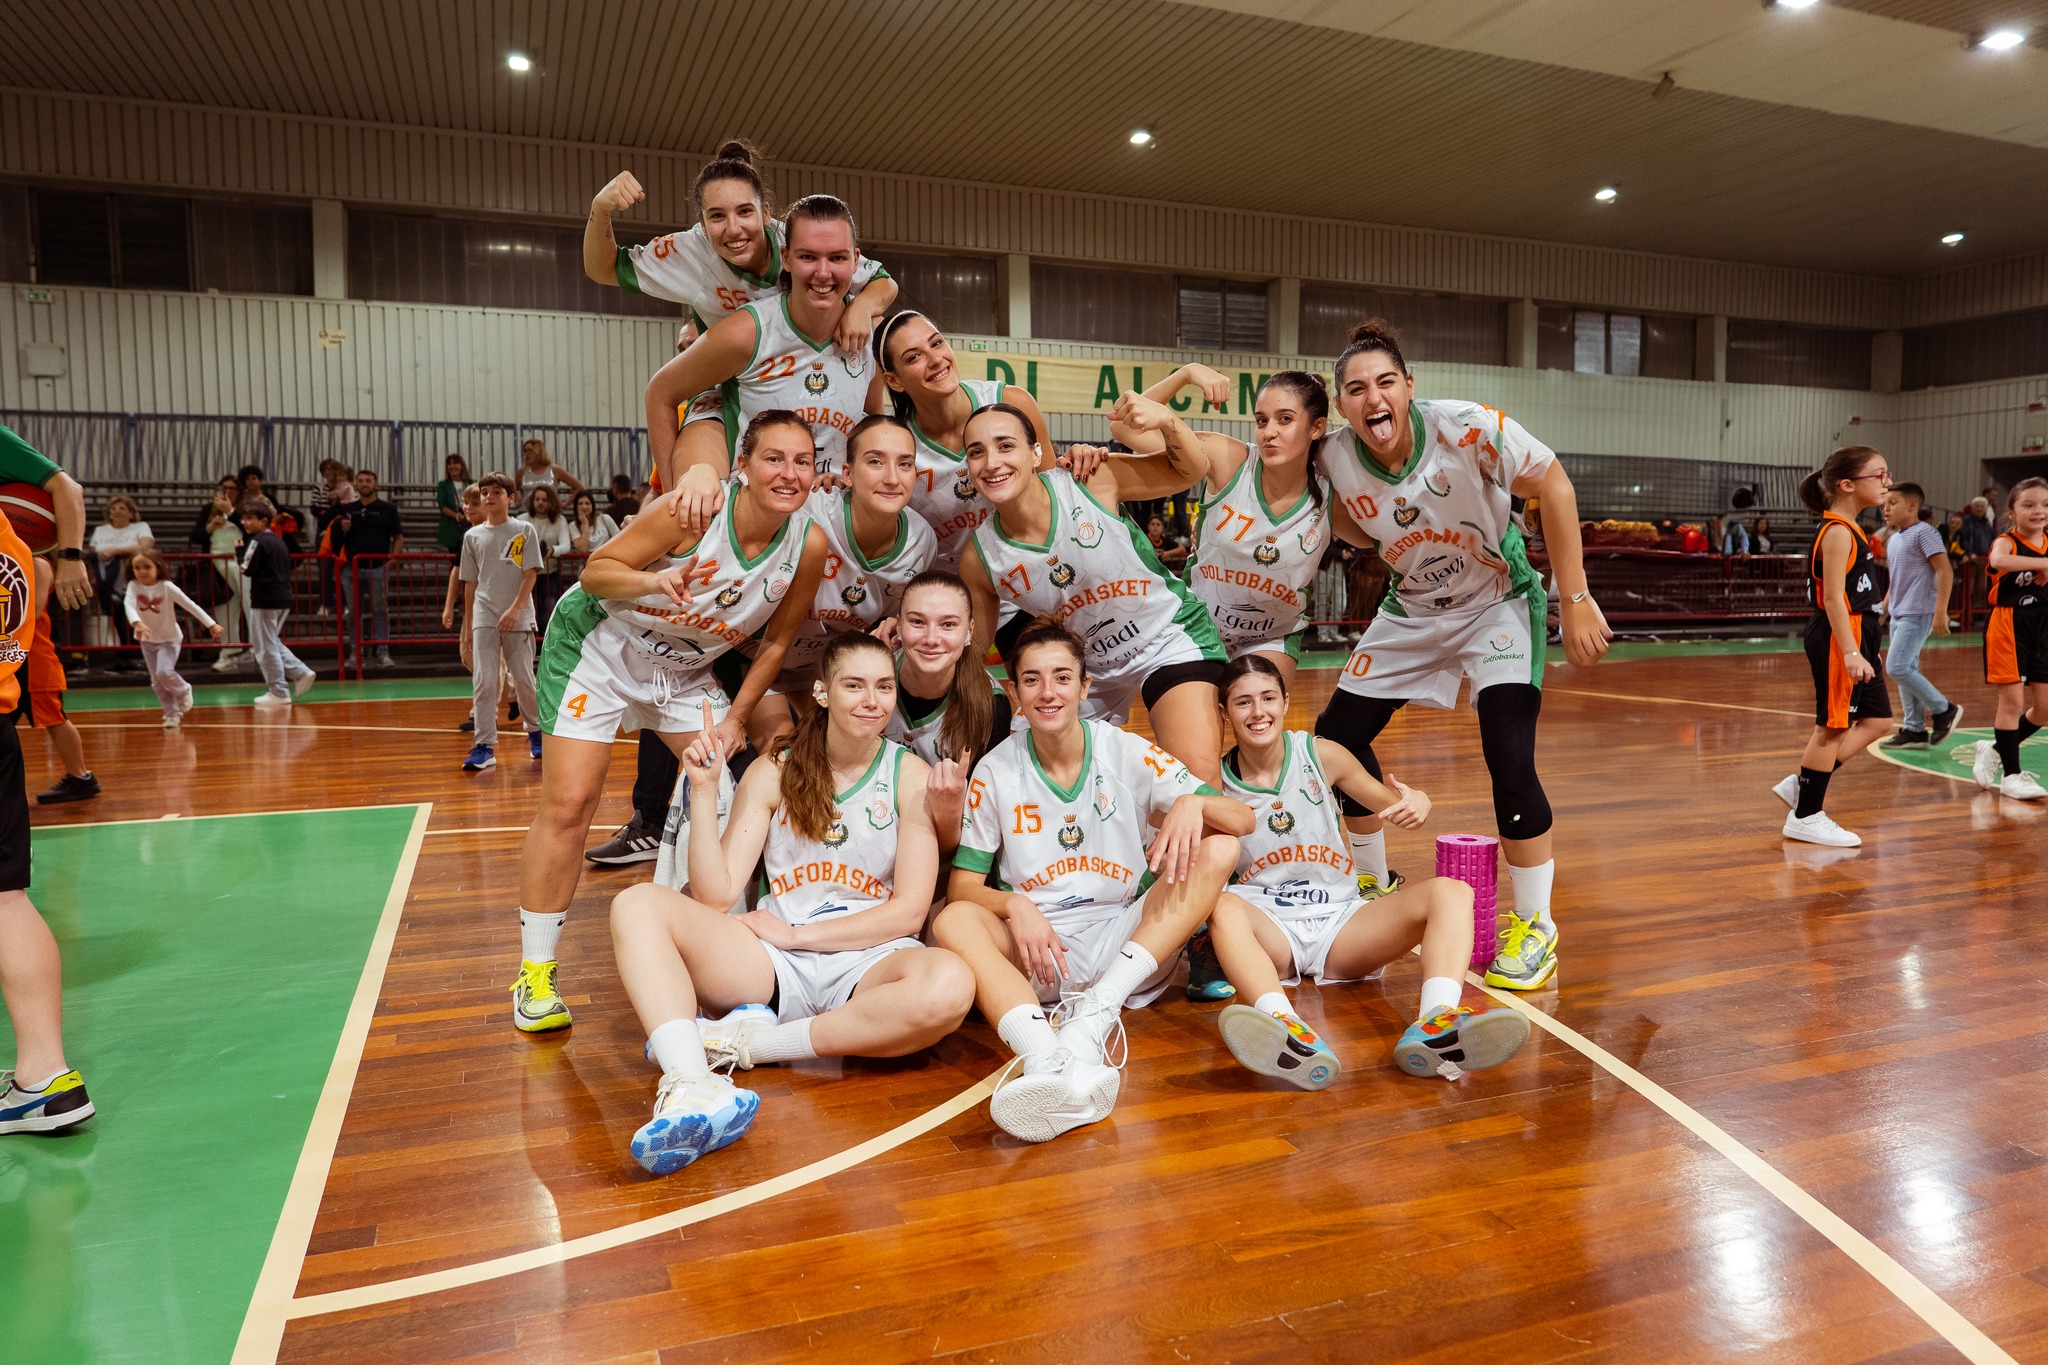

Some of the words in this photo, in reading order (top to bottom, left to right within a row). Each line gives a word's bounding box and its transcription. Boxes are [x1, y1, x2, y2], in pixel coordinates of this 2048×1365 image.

[758, 354, 797, 381] 22
[986, 358, 1038, 402] DI
[1347, 494, 1380, 520] 10
[1215, 503, 1256, 543] 77
[1000, 561, 1033, 600] 17
[1856, 572, 1872, 593] 64
[2014, 571, 2034, 587] 49
[1213, 605, 1276, 632] Egadi
[1085, 620, 1140, 658] gadi
[1343, 652, 1373, 678] 10
[567, 693, 590, 719] 4
[1012, 804, 1042, 834] 15
